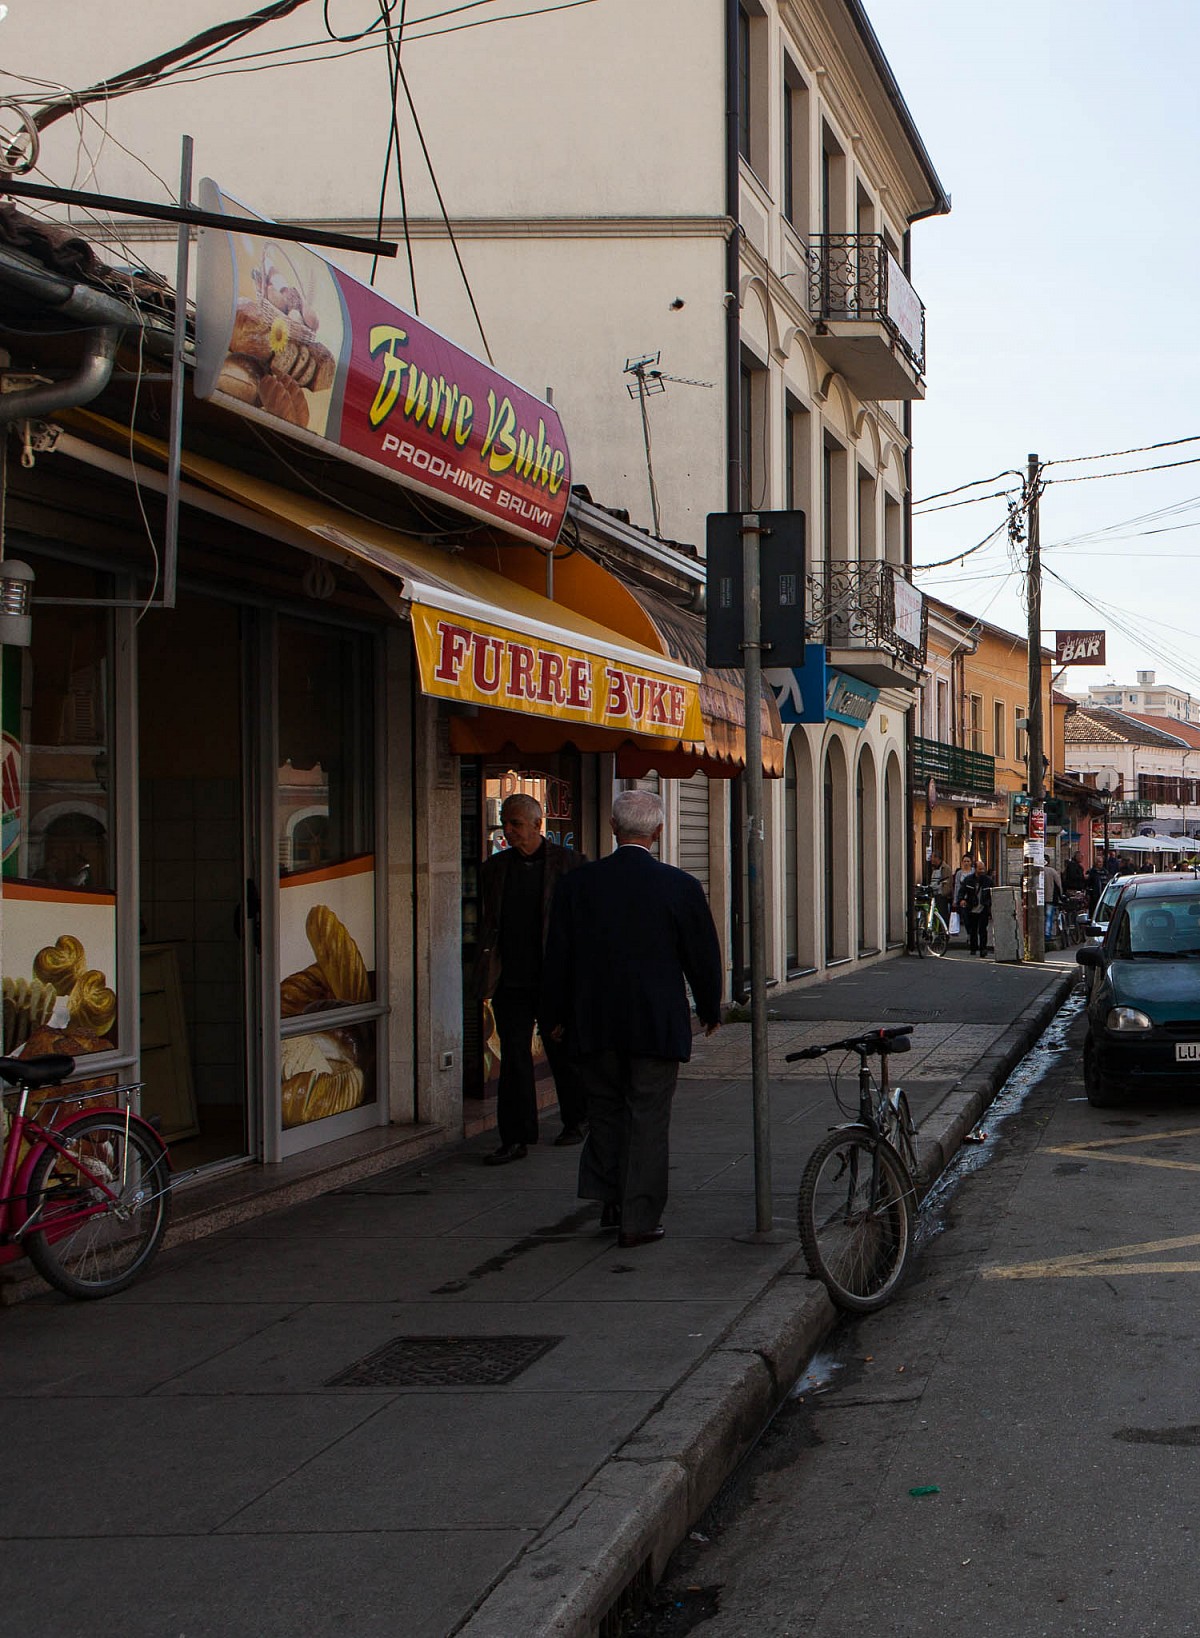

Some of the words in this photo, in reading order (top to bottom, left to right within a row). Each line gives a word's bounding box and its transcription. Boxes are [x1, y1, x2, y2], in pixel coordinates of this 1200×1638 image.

[369, 324, 474, 446] Furre
[480, 388, 566, 495] Buke
[380, 432, 495, 500] PRODHIME
[495, 490, 553, 529] BRUMI
[433, 620, 593, 711] FURRE
[604, 666, 687, 728] BUKE
[1061, 639, 1101, 662] BAR
[1178, 1045, 1197, 1059] LU
